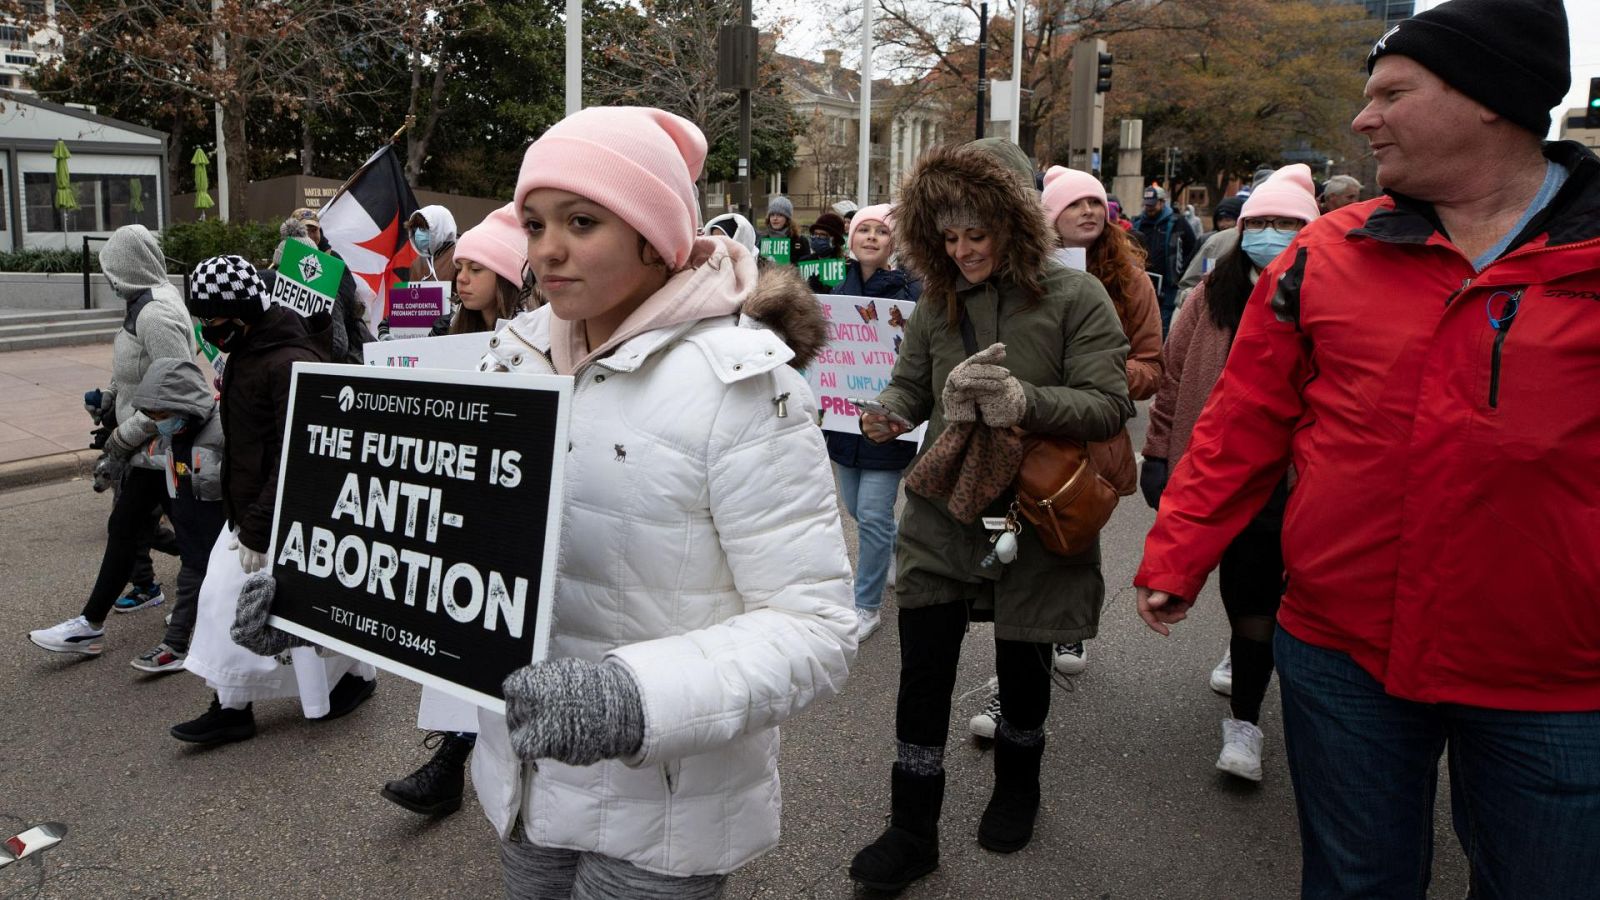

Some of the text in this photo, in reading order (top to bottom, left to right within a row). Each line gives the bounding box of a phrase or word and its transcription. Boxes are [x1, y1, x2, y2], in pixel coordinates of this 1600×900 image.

[773, 240, 789, 255] LIFE
[823, 261, 844, 281] LIFE
[405, 302, 438, 310] CONFIDENTIAL
[818, 349, 895, 366] BEGAN WITH
[820, 372, 836, 388] AN
[356, 392, 490, 422] STUDENTS FOR LIFE
[307, 424, 523, 488] THE FUTURE IS
[331, 472, 464, 543] ANTI-
[277, 521, 529, 639] ABORTION
[330, 606, 436, 656] TEXT LIFE TO 53445
